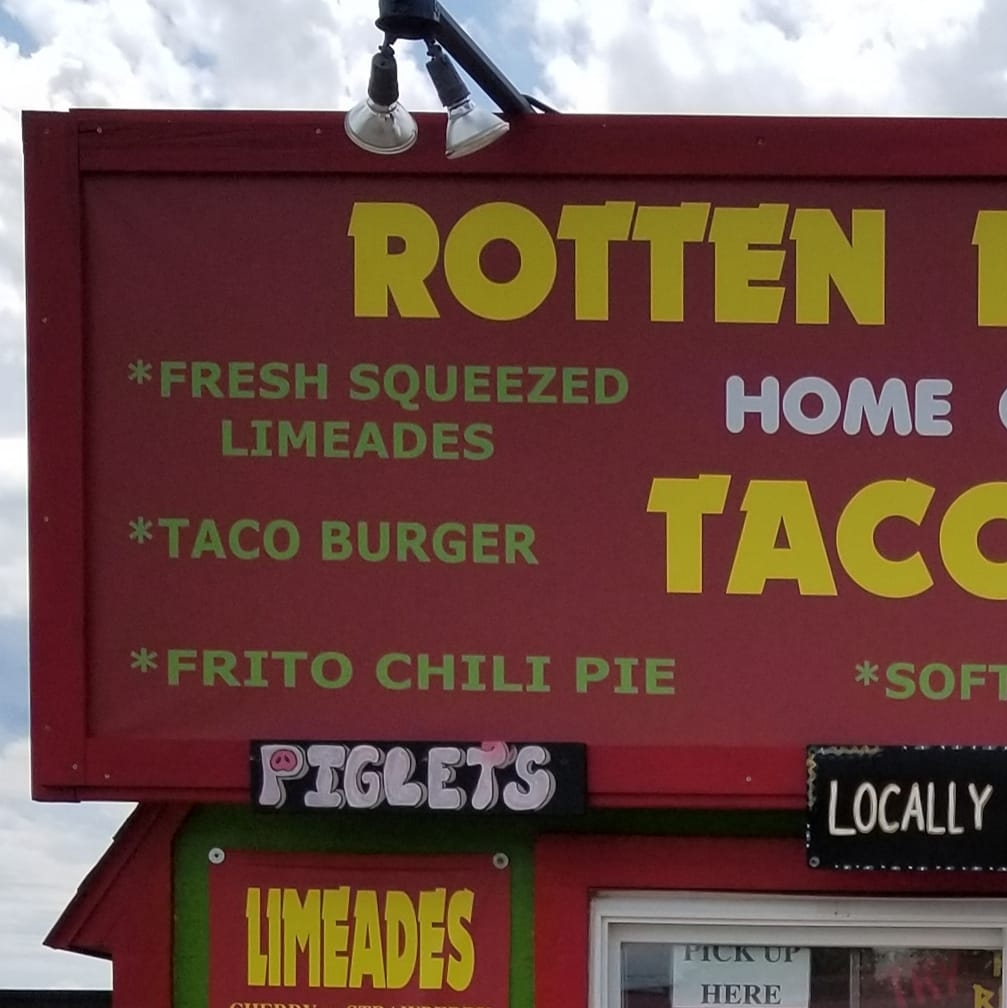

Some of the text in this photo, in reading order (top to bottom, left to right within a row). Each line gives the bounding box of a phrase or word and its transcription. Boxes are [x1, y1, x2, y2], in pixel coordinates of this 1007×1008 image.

[347, 201, 886, 326] ROTTEN
[349, 363, 629, 410] SQUEEZED
[725, 375, 953, 437] HOME
[222, 420, 495, 461] LIMEADES
[321, 521, 539, 565] BURGER
[375, 652, 551, 693] CHILI
[575, 656, 677, 695] PIE
[258, 742, 556, 811] PIGLETS
[828, 780, 994, 836] LOCALLY
[245, 885, 475, 992] LIMEADES
[684, 944, 800, 963] PICK UP
[701, 984, 782, 1005] HERE
